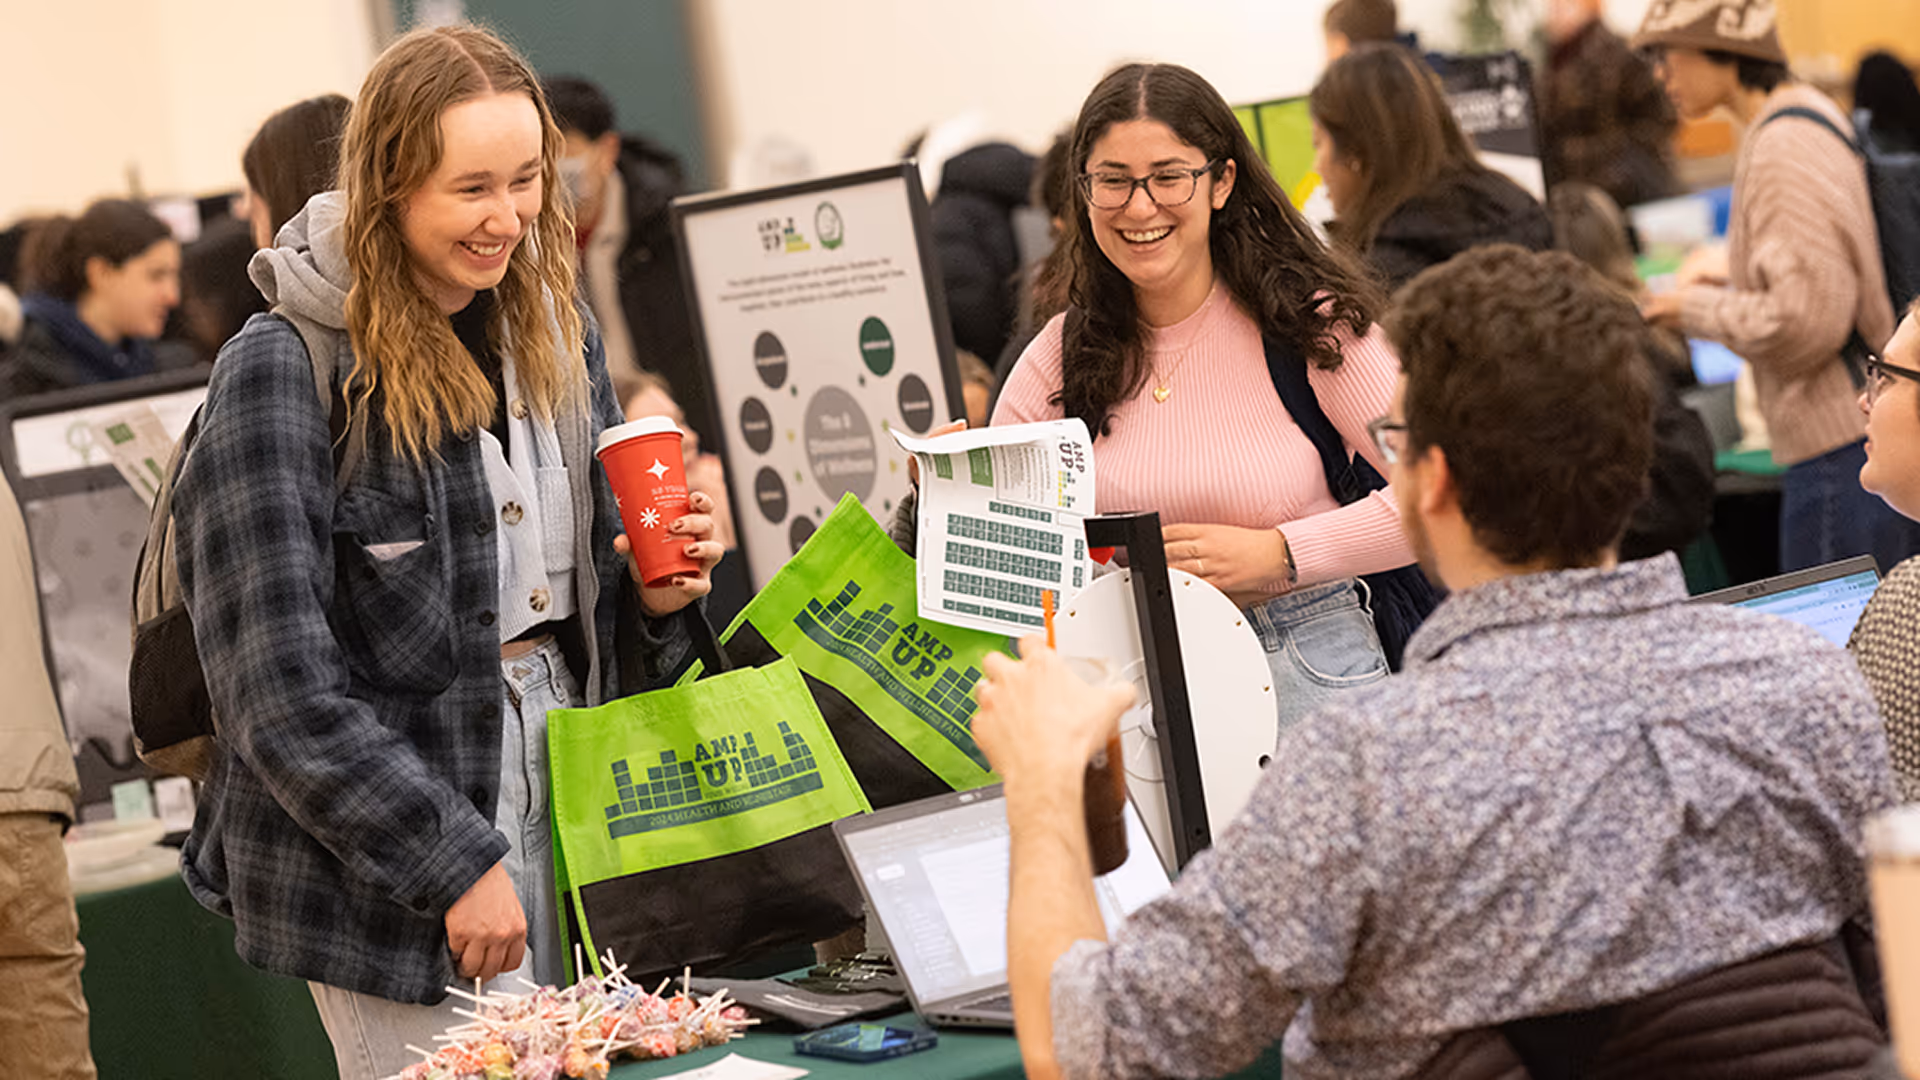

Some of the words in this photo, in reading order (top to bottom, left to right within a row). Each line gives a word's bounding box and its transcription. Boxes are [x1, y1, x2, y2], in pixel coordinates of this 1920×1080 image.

[1059, 442, 1074, 469] UP
[1071, 441, 1085, 473] AMP
[901, 622, 953, 662] AMP
[891, 636, 937, 681] UP
[879, 672, 898, 690] AND
[940, 720, 962, 740] FAIR
[695, 735, 738, 762] AMP
[701, 757, 743, 787] UP
[650, 814, 672, 827] 2024
[671, 805, 718, 823] HEALTH
[719, 800, 744, 811] AND
